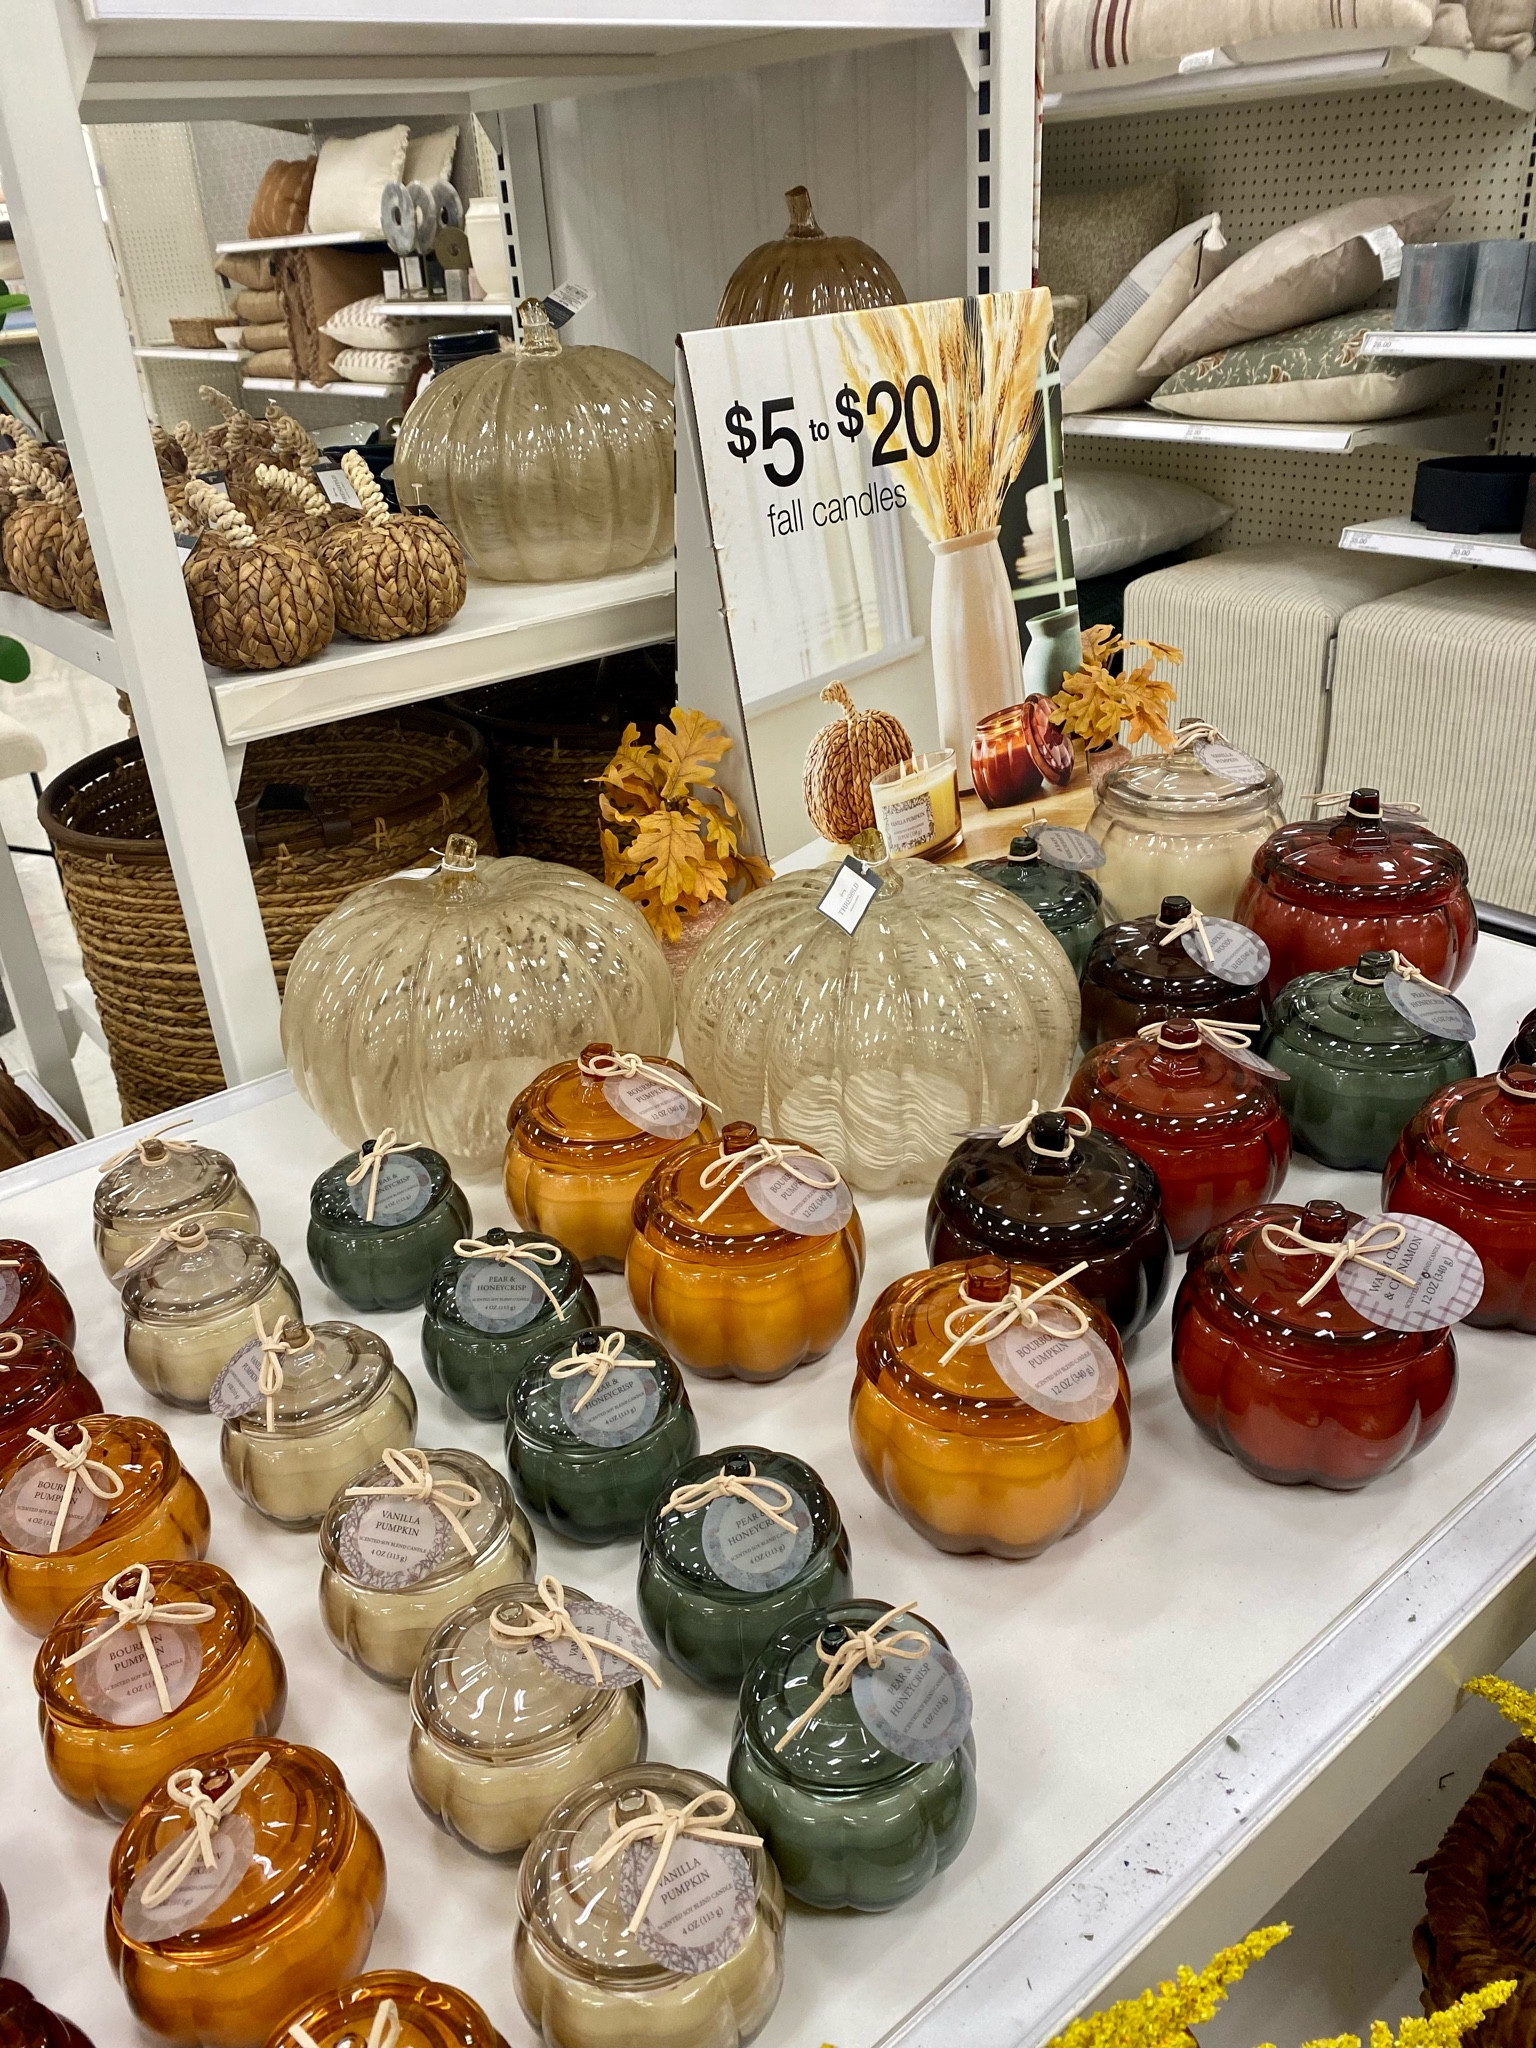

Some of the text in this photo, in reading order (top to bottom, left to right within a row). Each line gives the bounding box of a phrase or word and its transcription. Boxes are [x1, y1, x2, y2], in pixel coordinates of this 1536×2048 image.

[725, 374, 942, 488] $5 to $20
[767, 481, 908, 537] fall candles
[626, 1080, 657, 1097] BOURBO
[376, 1174, 392, 1186] EAR
[802, 1209, 811, 1218] 12
[808, 1202, 819, 1213] OZ
[1384, 1229, 1408, 1260] CID
[1384, 1235, 1424, 1300] & CINAMON
[1421, 1256, 1455, 1304] 12 OZ (340 g)
[1015, 1328, 1057, 1358] BOURBO
[1027, 1338, 1069, 1369] PUMPKIN
[592, 1377, 618, 1395] EAR &
[1050, 1364, 1096, 1395] 12 OZ (340 g)
[584, 1379, 634, 1410] HONEYCRISP
[608, 1414, 618, 1423] OZ
[34, 1491, 78, 1504] PUMPN
[37, 1480, 83, 1494] BOURN
[375, 1521, 419, 1536] PUMPKIN
[381, 1510, 420, 1524] VANILLA
[735, 1511, 758, 1529] PEAR
[386, 1551, 399, 1560] (113
[399, 1554, 407, 1562] g)
[753, 1552, 765, 1563] OZ
[764, 1546, 778, 1558] (113
[778, 1542, 786, 1552] g)
[108, 1633, 163, 1660] BOURN
[113, 1645, 165, 1671] PUMPN
[131, 1684, 144, 1694] OZ
[887, 1663, 913, 1695] PEAR &
[890, 1661, 931, 1717] HONEYCRISP
[924, 1712, 936, 1725] OZ
[656, 1855, 701, 1888] VANILLA
[660, 1868, 711, 1904] PUMPKIN
[680, 1905, 725, 1935] 4 OZ (113 g)
